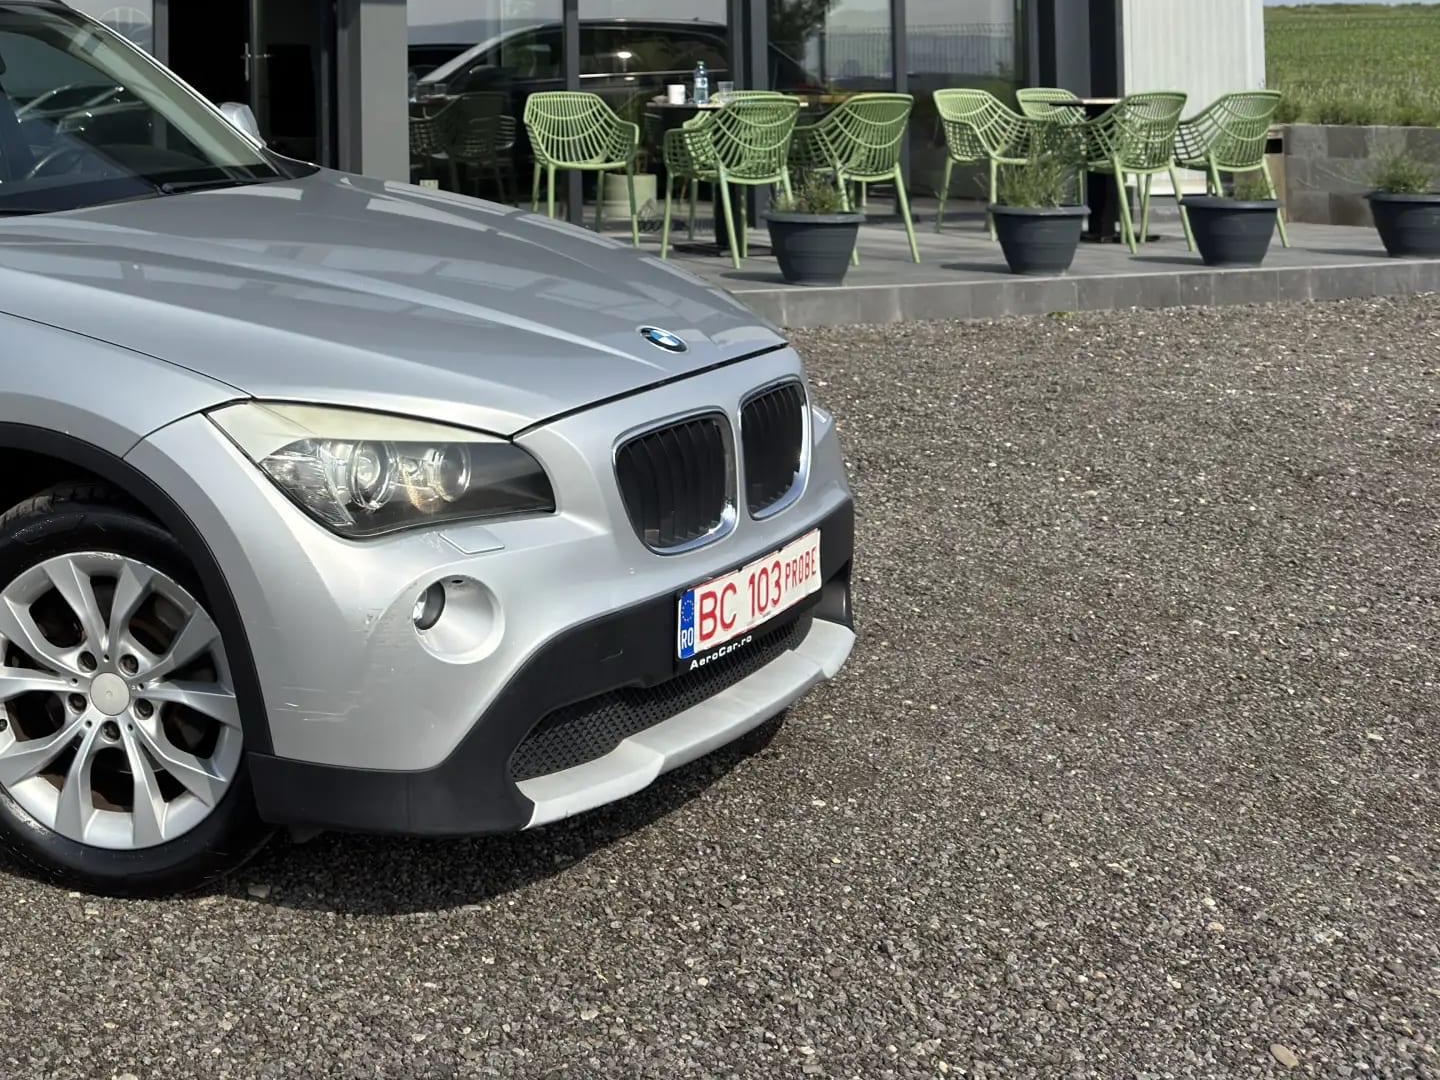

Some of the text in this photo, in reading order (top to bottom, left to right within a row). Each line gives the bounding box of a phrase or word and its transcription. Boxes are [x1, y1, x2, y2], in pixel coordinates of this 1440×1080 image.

[698, 546, 817, 642] BC 103 PROBE
[681, 627, 694, 650] RO
[690, 635, 753, 671] AeroCar.ro
